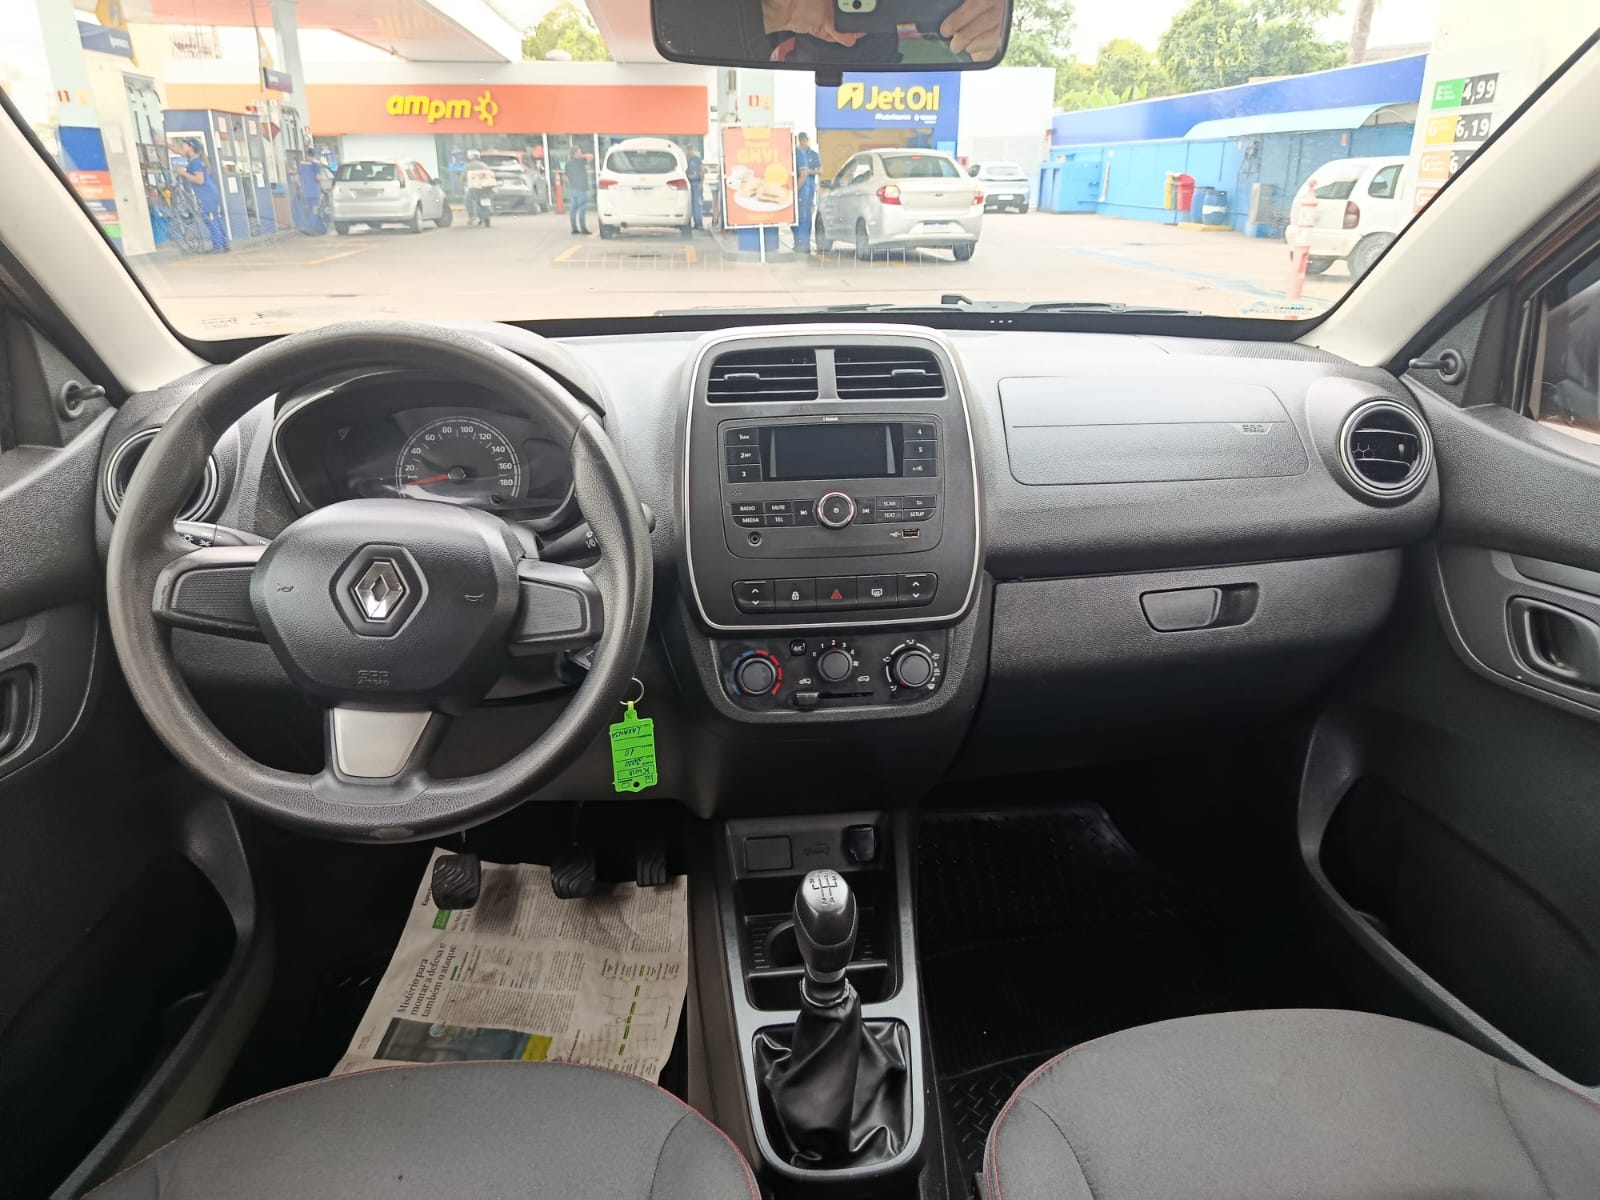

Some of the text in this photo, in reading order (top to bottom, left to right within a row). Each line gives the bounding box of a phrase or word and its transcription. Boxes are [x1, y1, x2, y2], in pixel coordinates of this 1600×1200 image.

[1463, 80, 1496, 104] 4,99
[386, 95, 473, 123] ampm
[1455, 118, 1490, 139] 6,19
[442, 426, 452, 434] 80
[410, 447, 422, 455] 40
[499, 462, 512, 470] 160
[397, 958, 429, 1013] Mistério para
[411, 983, 429, 1015] montar
[426, 950, 445, 976] defesa
[421, 981, 443, 1017] também
[441, 944, 457, 974] ataque
